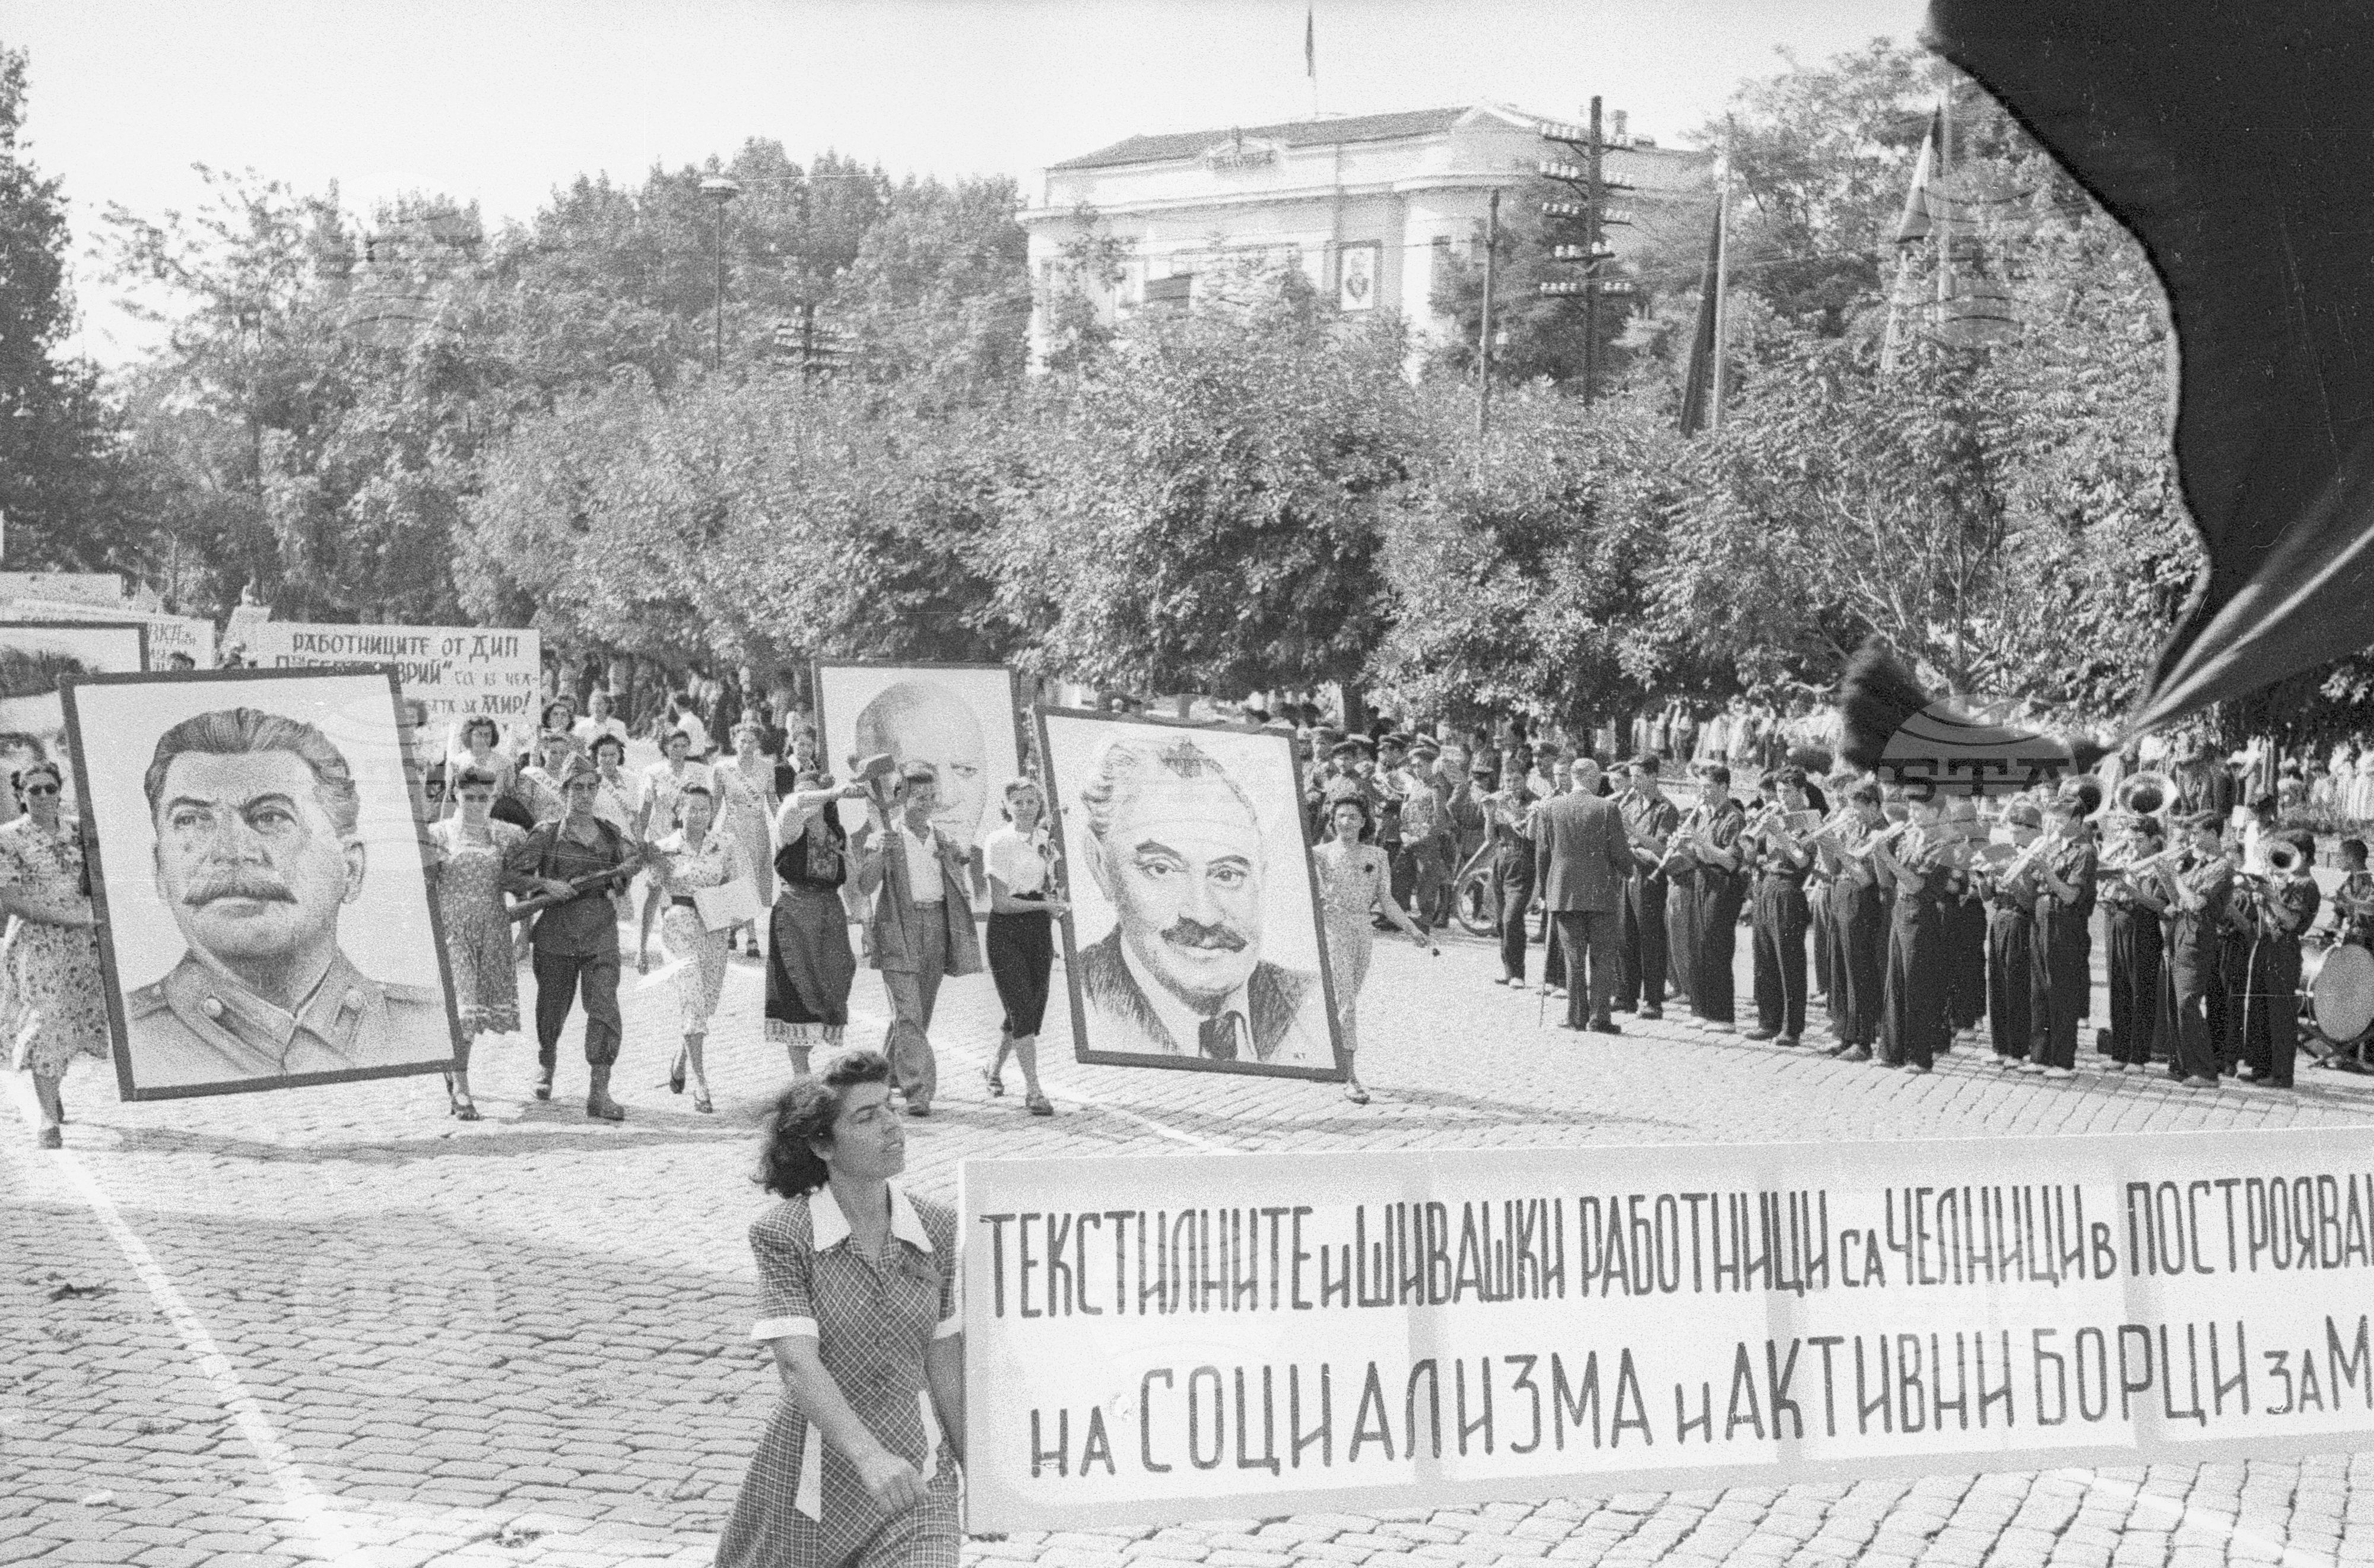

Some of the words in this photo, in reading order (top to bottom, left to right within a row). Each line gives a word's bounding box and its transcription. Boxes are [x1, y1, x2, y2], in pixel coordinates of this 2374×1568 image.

[294, 633, 429, 659] РАБОТНИЦИТЕ
[442, 637, 465, 656] ОТ
[469, 636, 518, 663] ДИП
[481, 691, 532, 715] МИР!
[979, 1206, 1313, 1318] ТЕКСТИЛНИТЕ
[1356, 1198, 1566, 1307] ШИВАШКИ
[1579, 1189, 1830, 1297] РАБОТНИЦИ
[1840, 1229, 1886, 1288] СА
[1886, 1185, 2085, 1288] ЧЕЛНИЦИ
[2126, 1173, 2374, 1277] ПОСТРОЯВА
[1030, 1406, 1116, 1478] НА
[1140, 1347, 1653, 1476] СОЦИАЛИЗМА
[1725, 1330, 2014, 1440] АКТИВНИ
[2033, 1321, 2250, 1427] БОРЦИ
[2264, 1350, 2325, 1415] ЗА
